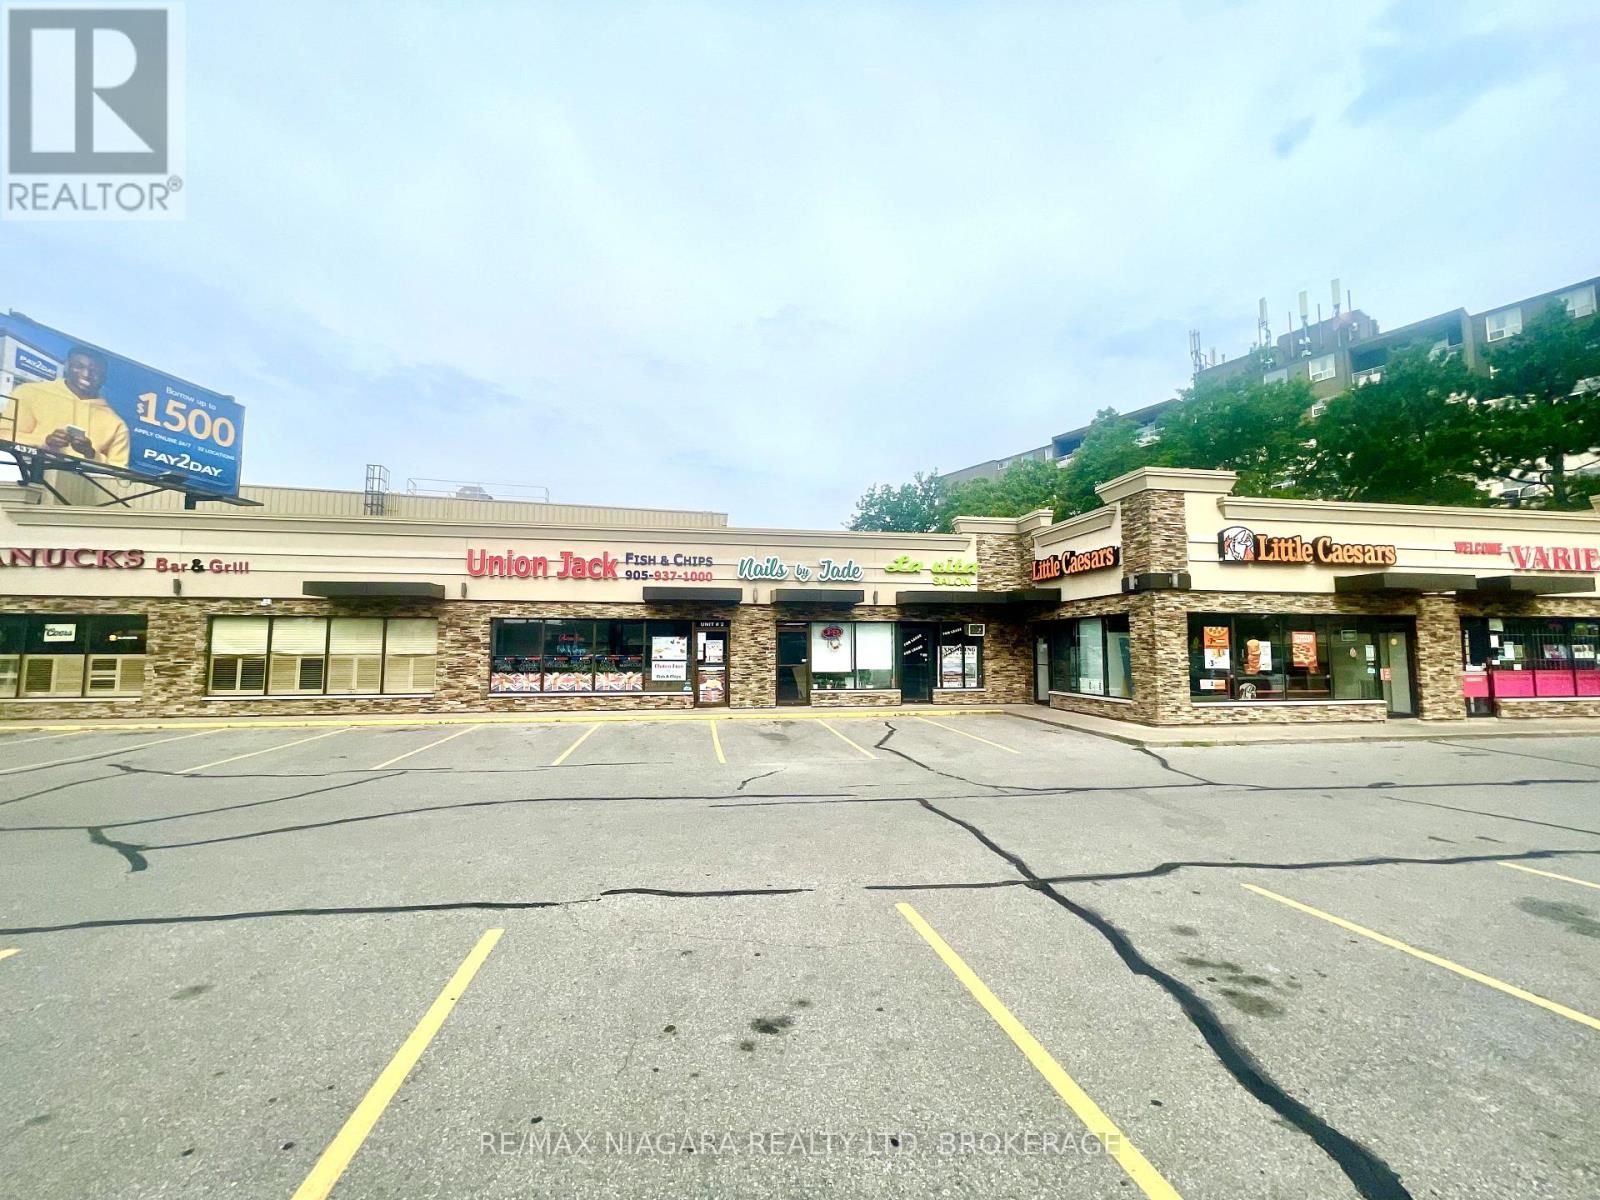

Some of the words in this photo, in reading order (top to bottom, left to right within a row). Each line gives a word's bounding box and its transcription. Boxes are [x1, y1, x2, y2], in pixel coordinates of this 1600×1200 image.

[166, 387, 194, 402] Borrow
[196, 399, 206, 407] up
[208, 402, 216, 411] to
[136, 392, 235, 448] $1500
[14, 444, 38, 455] 4375
[134, 427, 154, 437] APPLY
[155, 432, 178, 444] ONLINE
[205, 447, 235, 461] LOCATIONS
[144, 448, 223, 477] PAY2DAY
[0, 547, 145, 569] NUCKS
[625, 552, 656, 566] FISH
[660, 555, 669, 566] &
[673, 553, 713, 567] CHIPS
[1256, 534, 1314, 563] Little
[1316, 536, 1397, 565] Caesars
[1510, 546, 1600, 571] VARIE
[466, 548, 548, 578] Union
[556, 551, 619, 580] Jack
[625, 570, 713, 582] 905-937-1000
[738, 557, 788, 579] Nails
[796, 564, 811, 580] by
[817, 559, 863, 581] Jade
[1031, 555, 1061, 581] Little
[1061, 546, 1116, 575] Caesars
